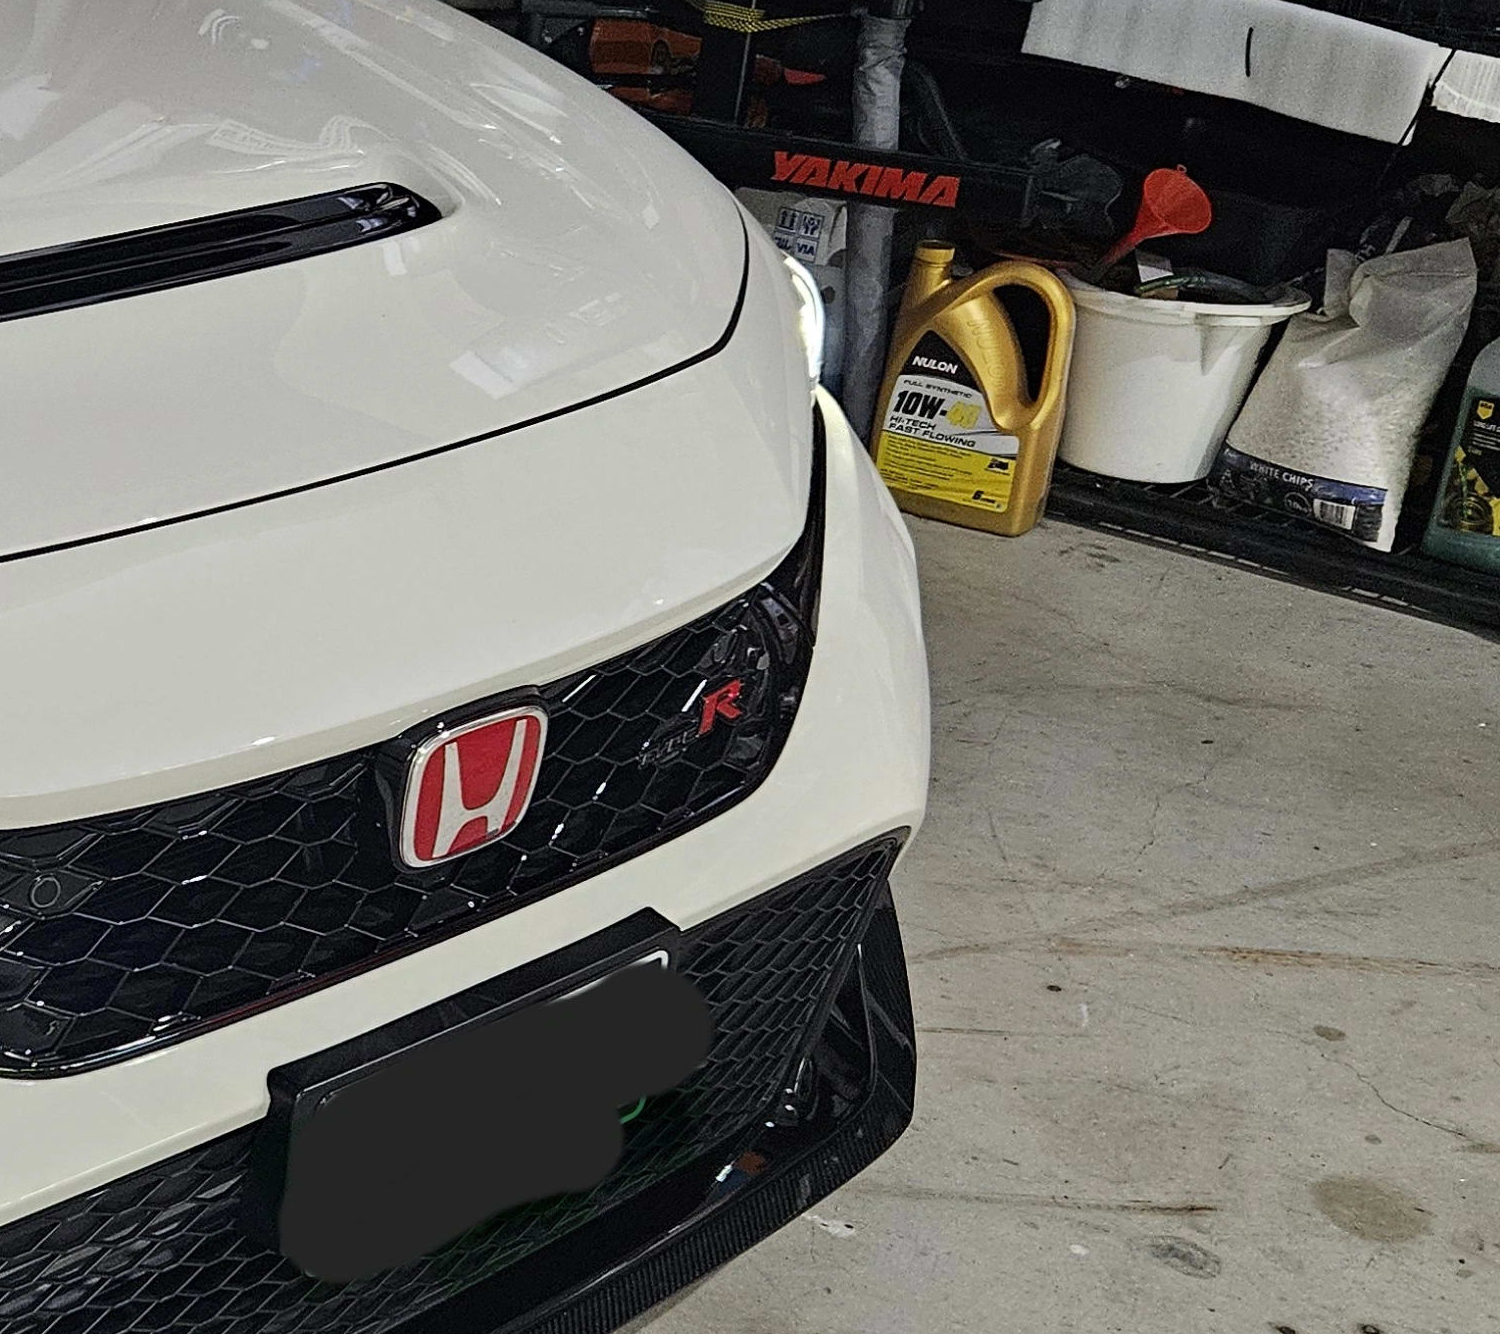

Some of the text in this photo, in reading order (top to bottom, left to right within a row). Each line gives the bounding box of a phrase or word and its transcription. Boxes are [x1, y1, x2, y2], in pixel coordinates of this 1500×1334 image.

[770, 151, 962, 208] YAKIMA
[912, 355, 959, 375] NULON
[888, 422, 976, 448] FAST FLOWING
[1250, 462, 1314, 492] WHITE CHIPS
[700, 678, 744, 736] R
